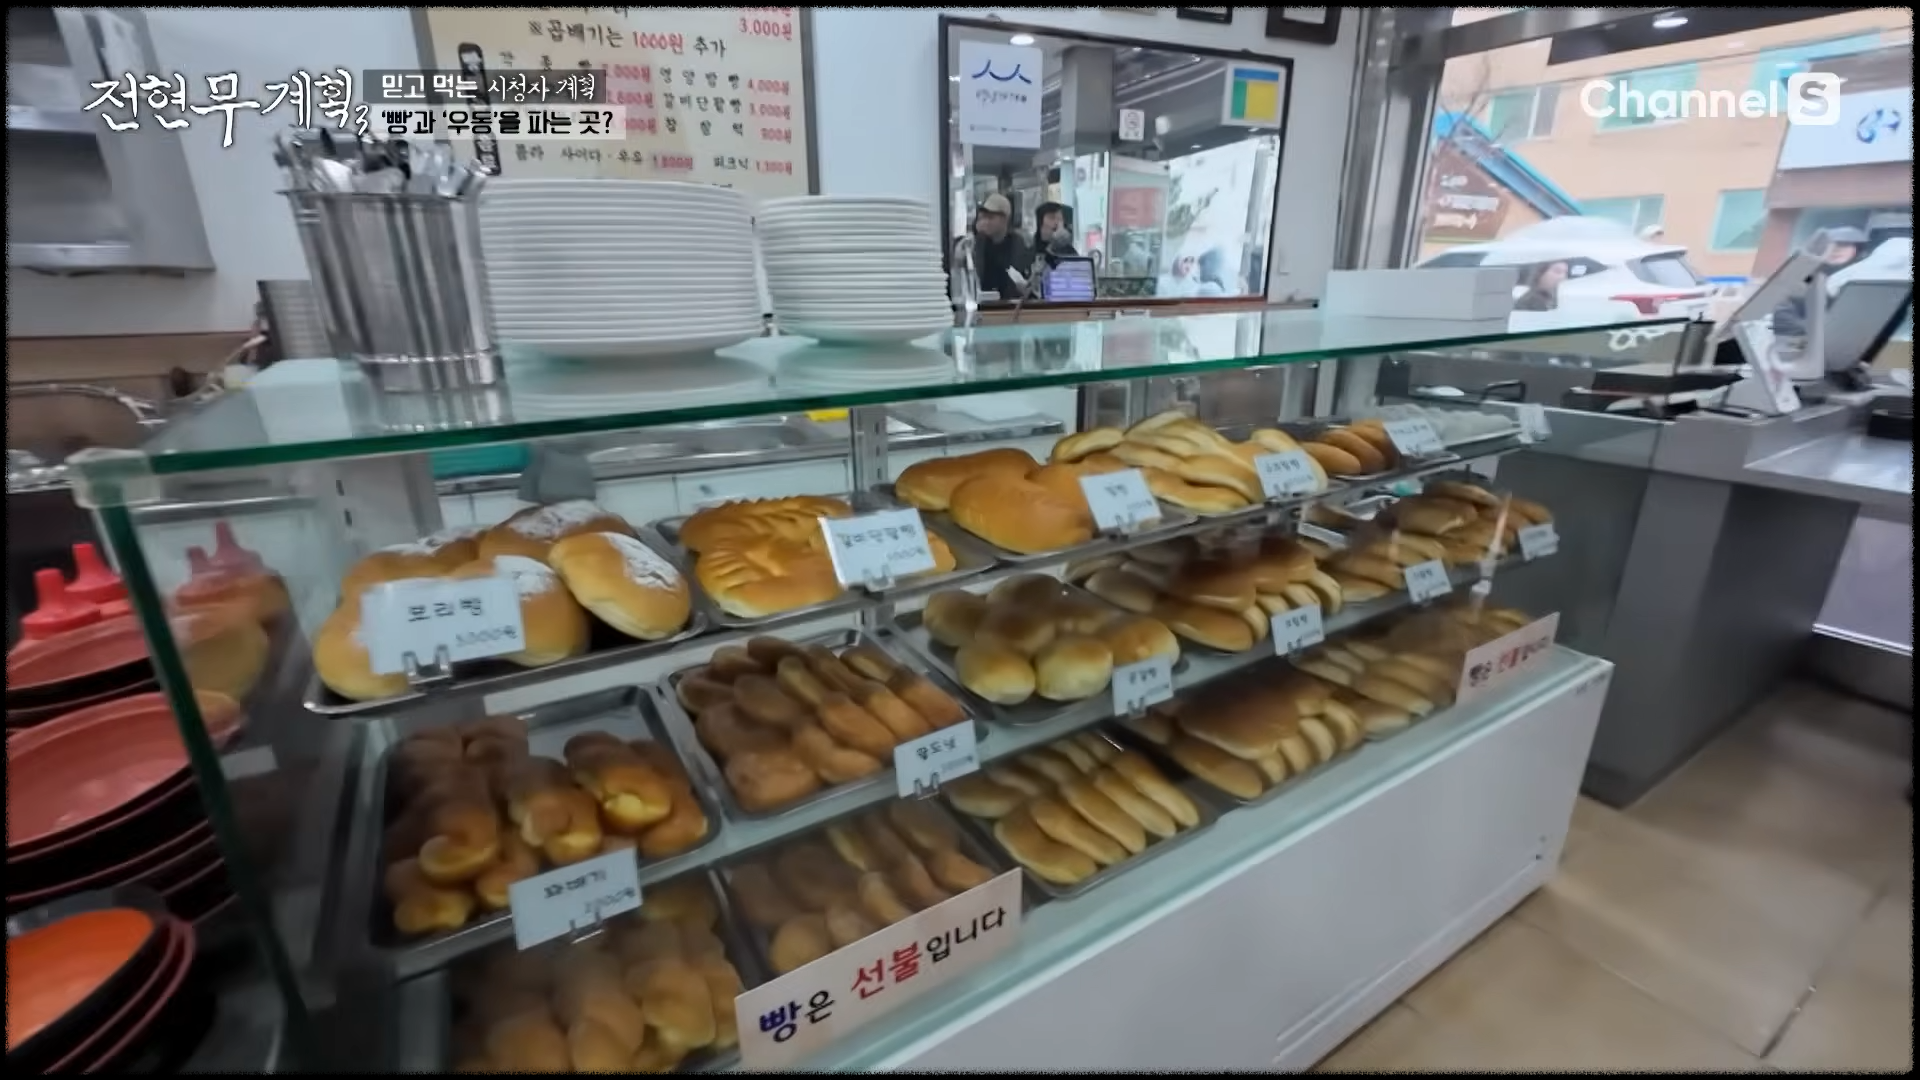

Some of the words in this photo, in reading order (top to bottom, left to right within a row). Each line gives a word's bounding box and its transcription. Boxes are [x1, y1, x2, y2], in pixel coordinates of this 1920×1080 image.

[634, 31, 684, 55] 1000원
[694, 36, 727, 58] 추가
[408, 598, 482, 622] 보리빵
[759, 990, 835, 1043] 빵은
[852, 906, 1007, 1000] 선불입니다
